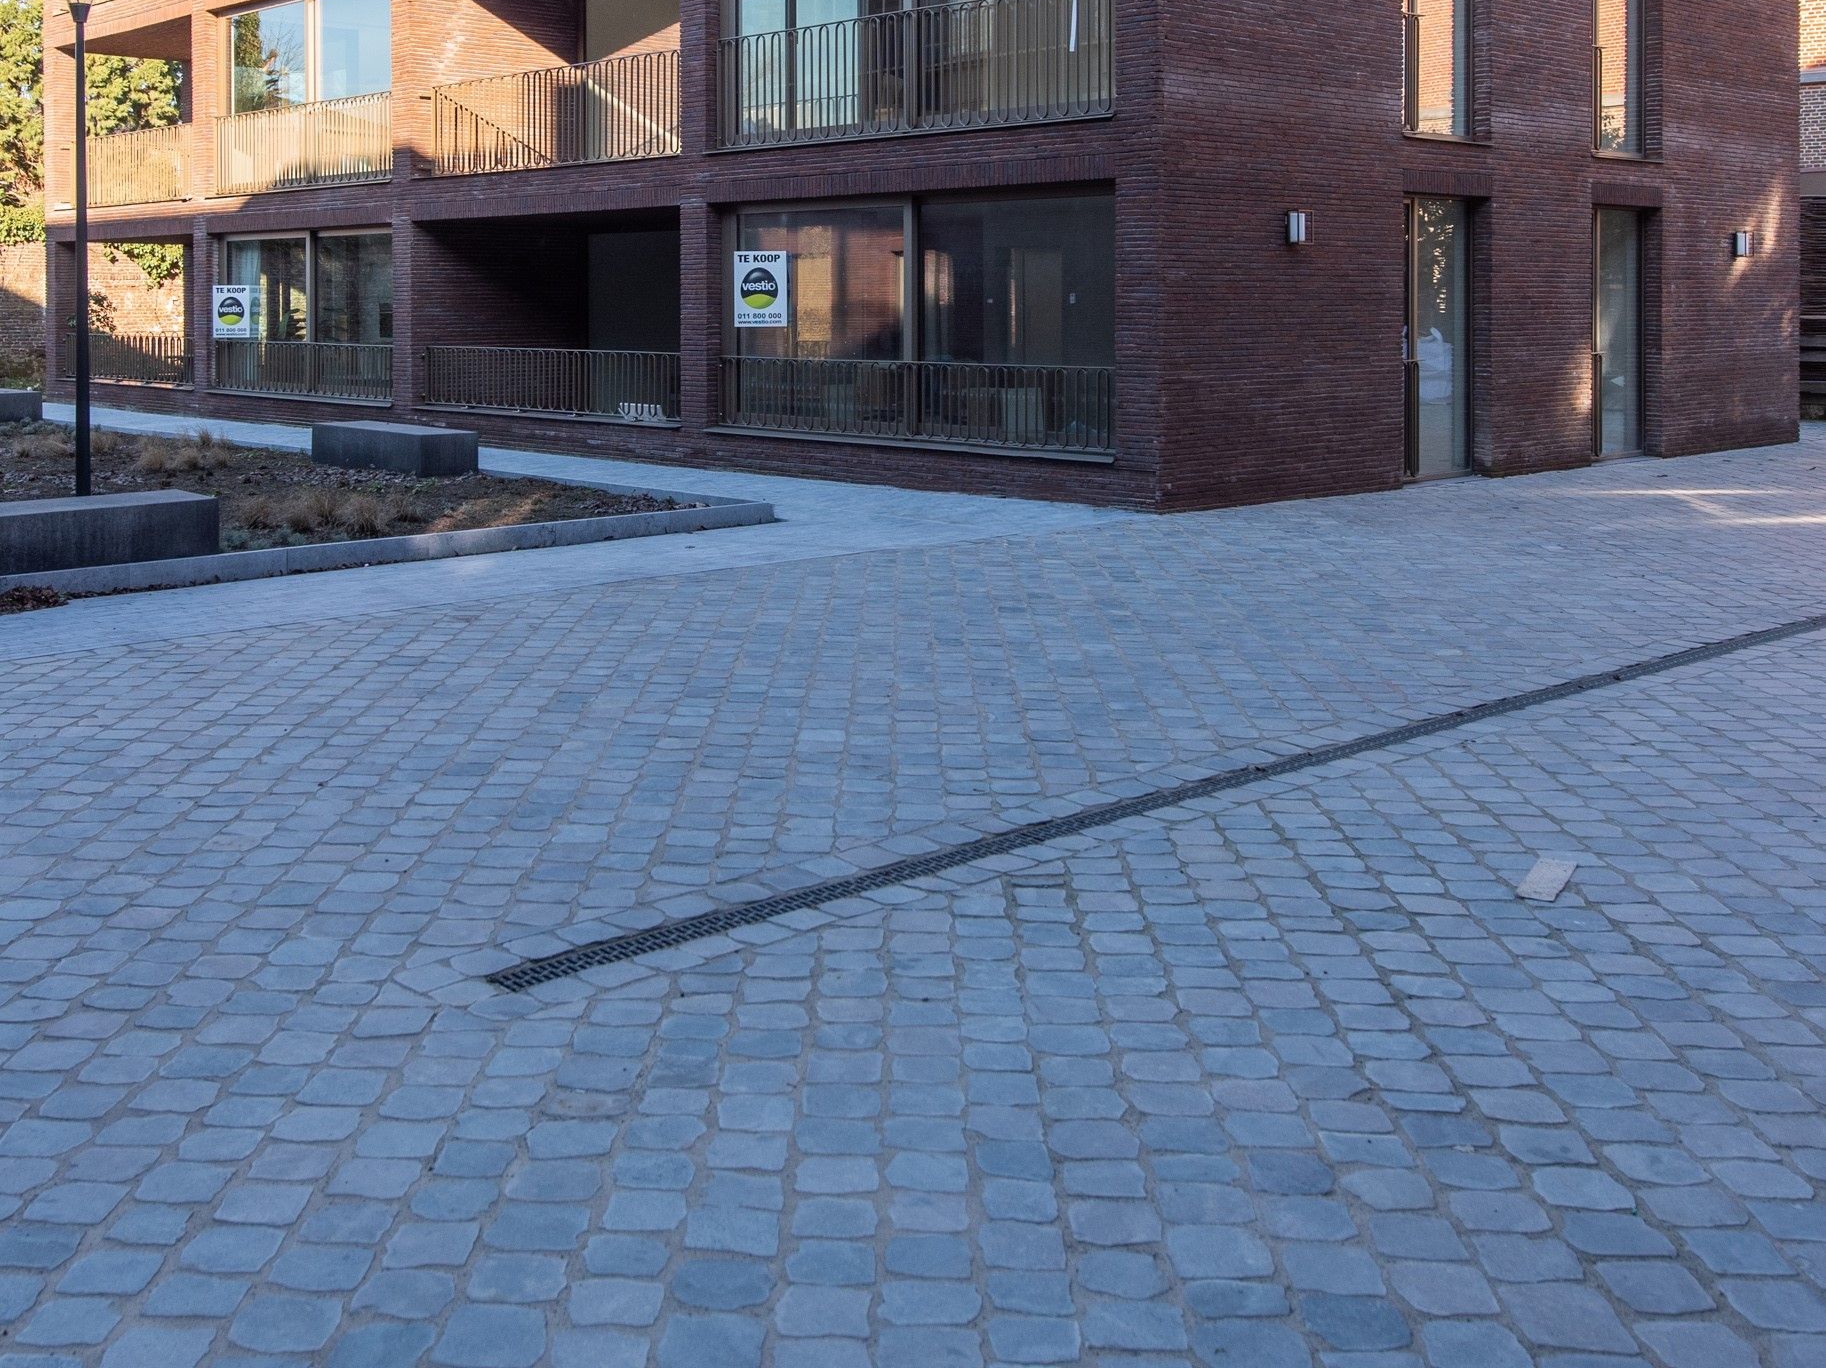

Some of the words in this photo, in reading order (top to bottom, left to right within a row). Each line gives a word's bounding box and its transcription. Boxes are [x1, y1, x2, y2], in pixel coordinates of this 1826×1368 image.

[737, 254, 750, 262] TE
[753, 254, 781, 262] KOOP
[742, 280, 776, 291] vestio
[219, 305, 243, 313] vestio
